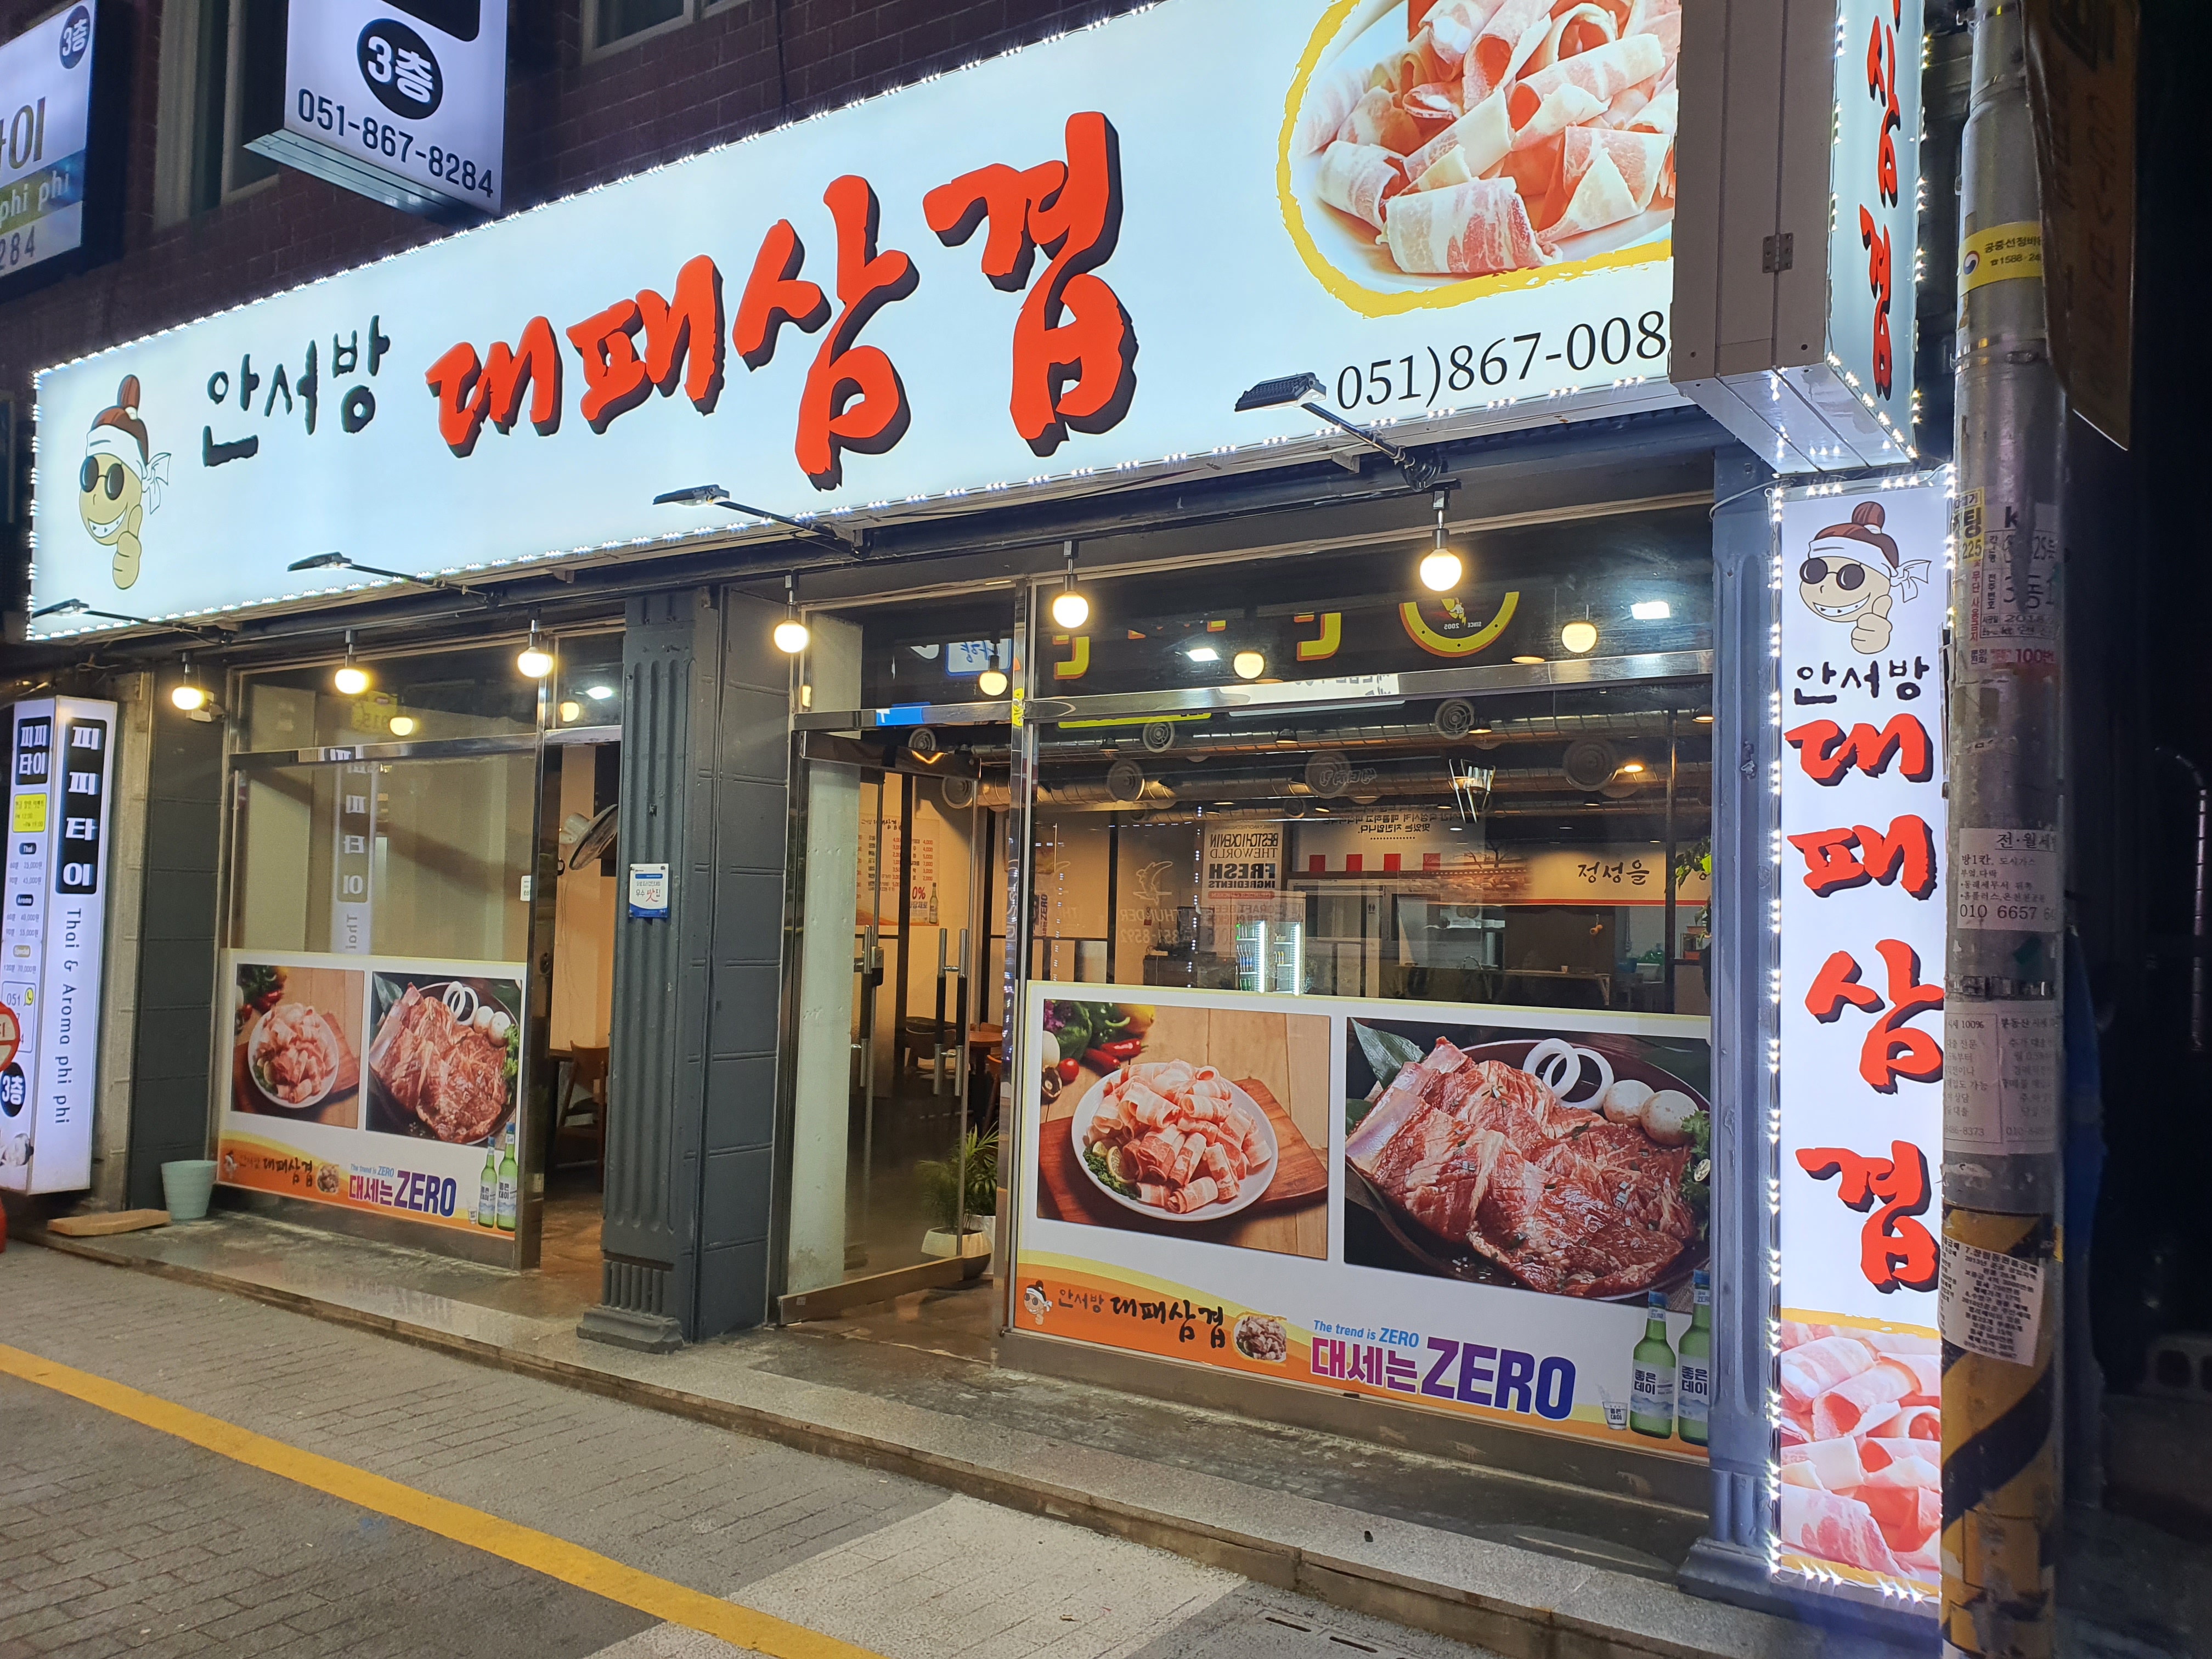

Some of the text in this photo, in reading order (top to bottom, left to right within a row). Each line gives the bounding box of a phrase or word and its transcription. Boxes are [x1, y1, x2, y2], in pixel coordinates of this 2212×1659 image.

[62, 19, 87, 57] 3층
[367, 35, 432, 103] 3층
[0, 96, 46, 170] 이
[298, 88, 494, 198] 051-867-8284
[38, 164, 70, 212] phi
[202, 111, 1139, 492] 안서방 대패삼겹
[1794, 656, 1930, 706] 안서방
[20, 724, 48, 748] 피피
[18, 752, 47, 776] 타이
[63, 726, 101, 887] 피피타이
[1577, 859, 1650, 885] 정성을
[1960, 904, 1988, 918] 010
[1996, 905, 2038, 919] 6657
[7, 992, 21, 1006] 051
[53, 907, 82, 1124] Thai & Aroma phi phi
[1784, 713, 1945, 1294] 대패삼겹
[2, 1075, 24, 1105] 3층
[377, 1165, 394, 1178] ZERO
[348, 1170, 457, 1217] 대세는 ZERO
[1058, 1289, 1226, 1348] 안서방 대패삼겹
[1313, 1319, 1420, 1348] The trend is ZERO
[1311, 1336, 1577, 1420] 대세는 ZERO
[1634, 1368, 1656, 1384] 좋은
[1634, 1380, 1656, 1395] 데이
[1681, 1365, 1708, 1383] 좋은
[1681, 1379, 1708, 1396] 데이
